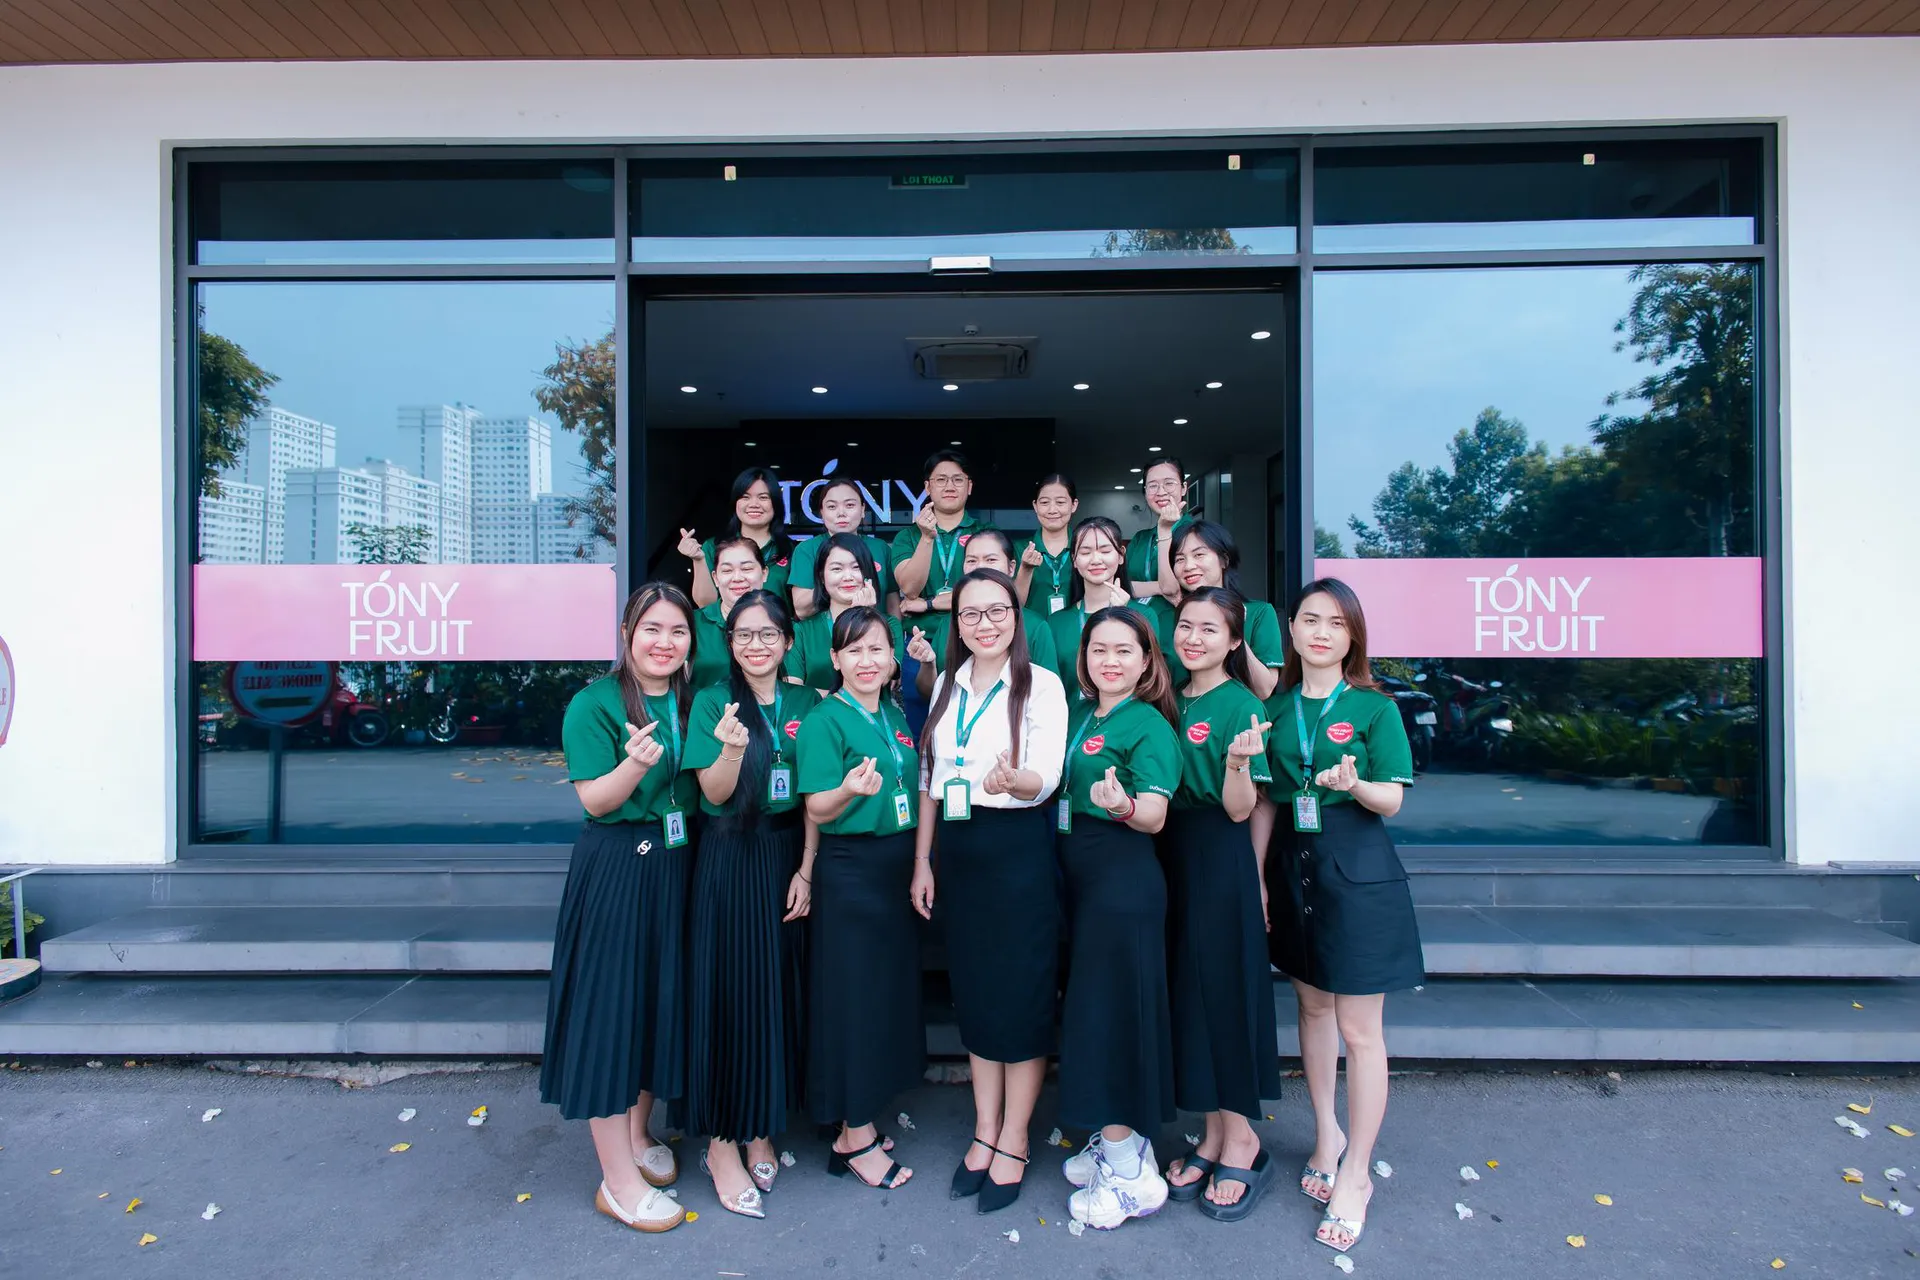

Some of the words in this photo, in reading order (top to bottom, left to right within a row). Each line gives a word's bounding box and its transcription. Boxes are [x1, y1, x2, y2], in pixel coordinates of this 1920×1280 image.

[341, 569, 460, 617] TÓNY
[1466, 564, 1592, 613] TÓNY
[349, 619, 473, 656] FRUIT
[1475, 615, 1604, 651] FRUIT
